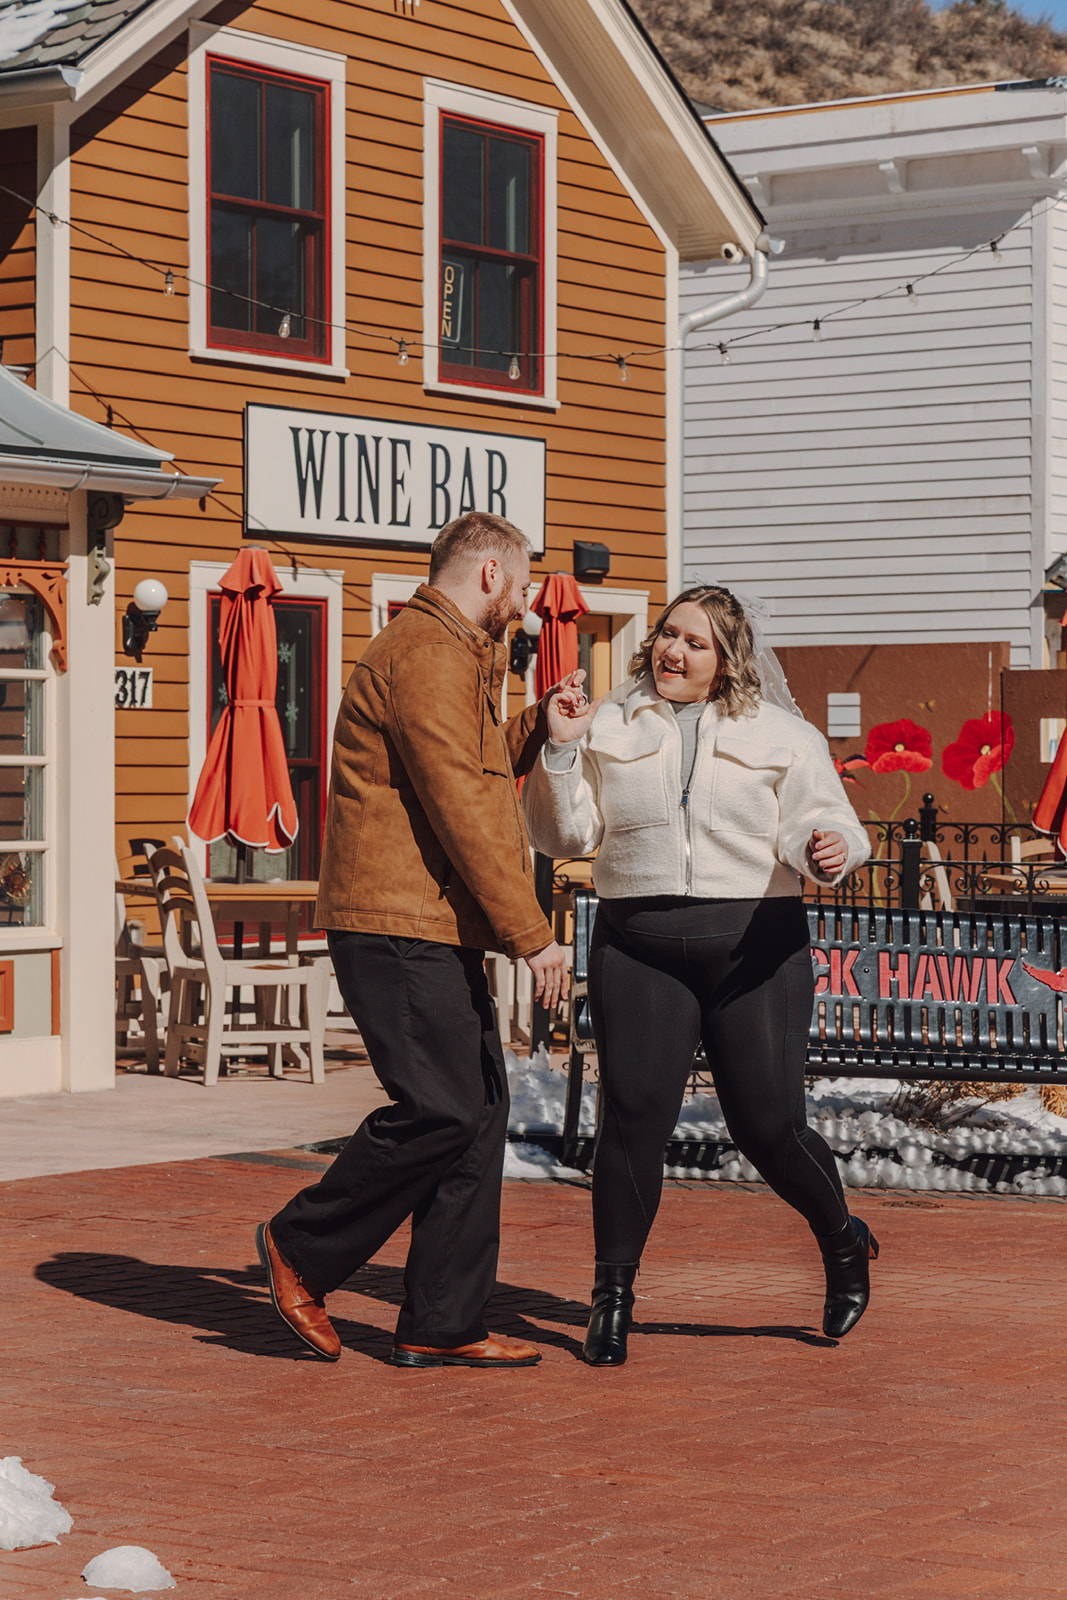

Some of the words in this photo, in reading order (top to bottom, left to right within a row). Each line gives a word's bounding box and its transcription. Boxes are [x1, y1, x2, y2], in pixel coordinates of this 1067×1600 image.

[441, 265, 455, 338] OPEN
[288, 426, 412, 525] WINE
[427, 442, 507, 529] BAR
[115, 670, 151, 707] 317
[878, 951, 1018, 1005] HAWK
